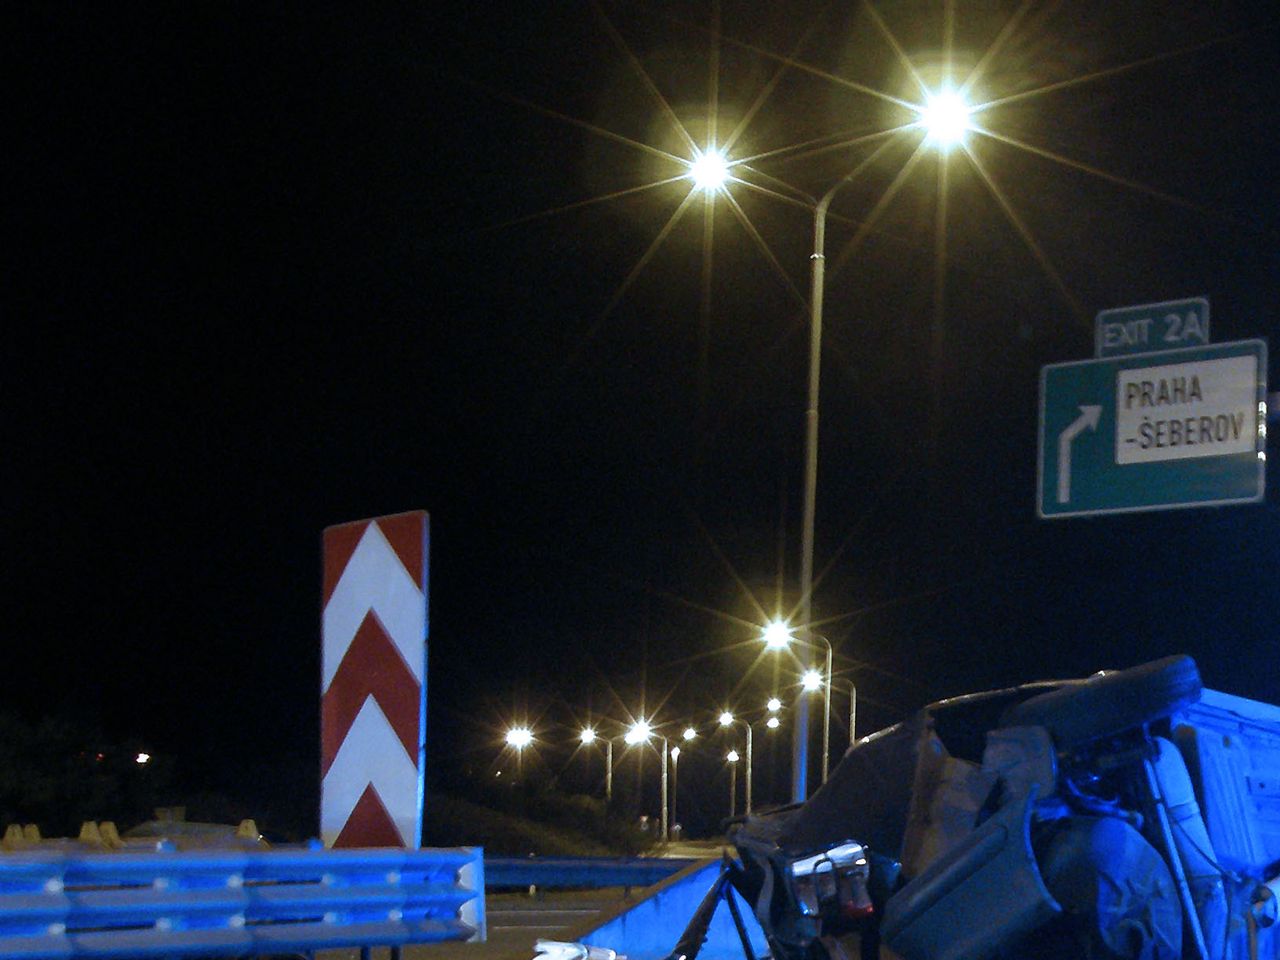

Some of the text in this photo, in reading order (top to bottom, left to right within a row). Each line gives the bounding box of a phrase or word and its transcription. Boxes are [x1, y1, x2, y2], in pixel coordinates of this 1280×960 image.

[1103, 312, 1203, 348] EXIT 2A
[1125, 375, 1203, 409] PRAHA
